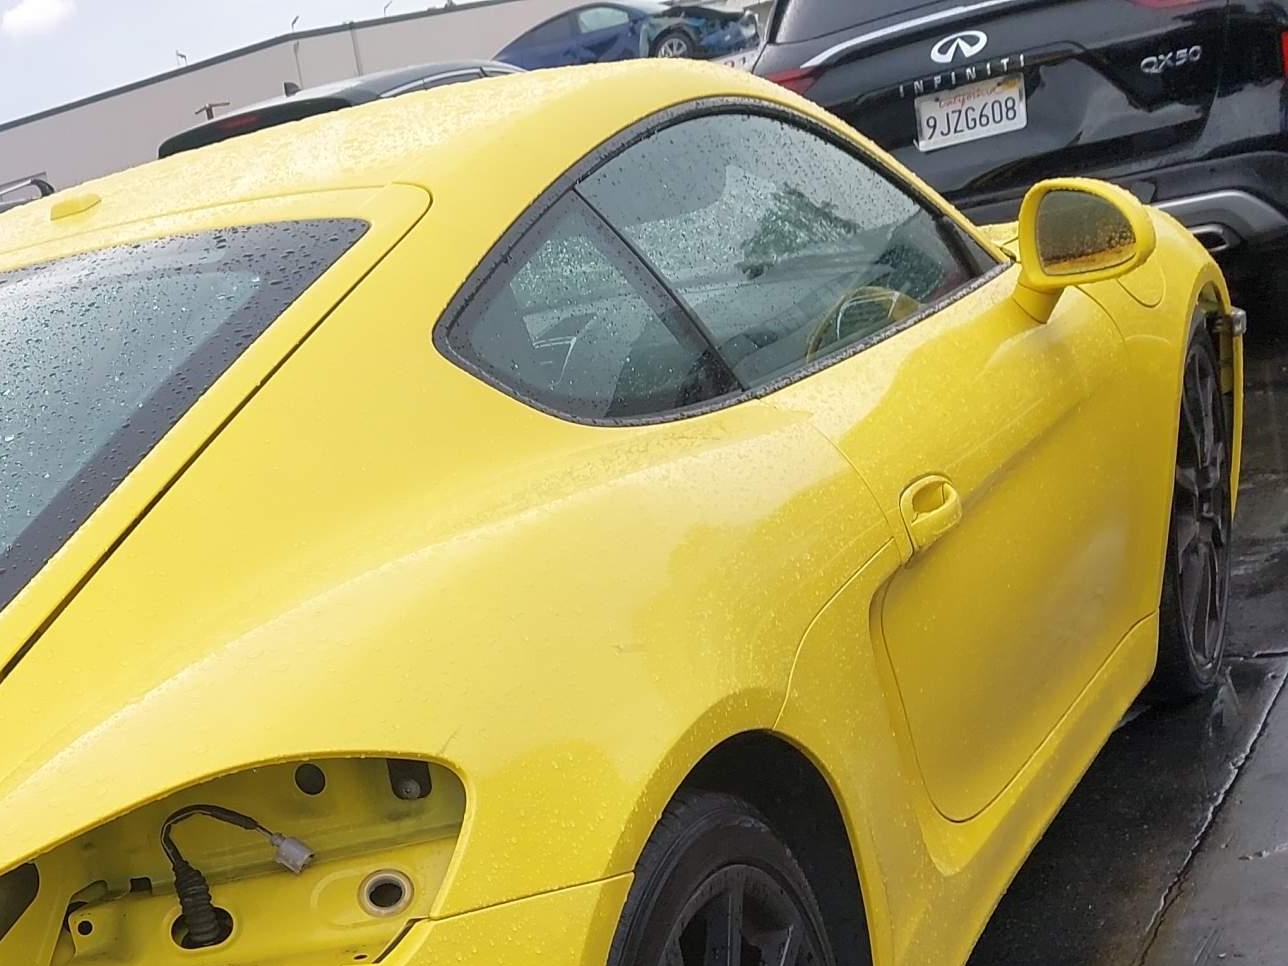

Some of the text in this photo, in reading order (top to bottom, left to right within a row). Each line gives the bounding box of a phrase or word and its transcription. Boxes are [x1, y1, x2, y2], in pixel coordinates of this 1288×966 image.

[899, 53, 1024, 98] INFINITI
[1140, 45, 1202, 74] QX50
[926, 97, 1017, 140] 9JZG608
